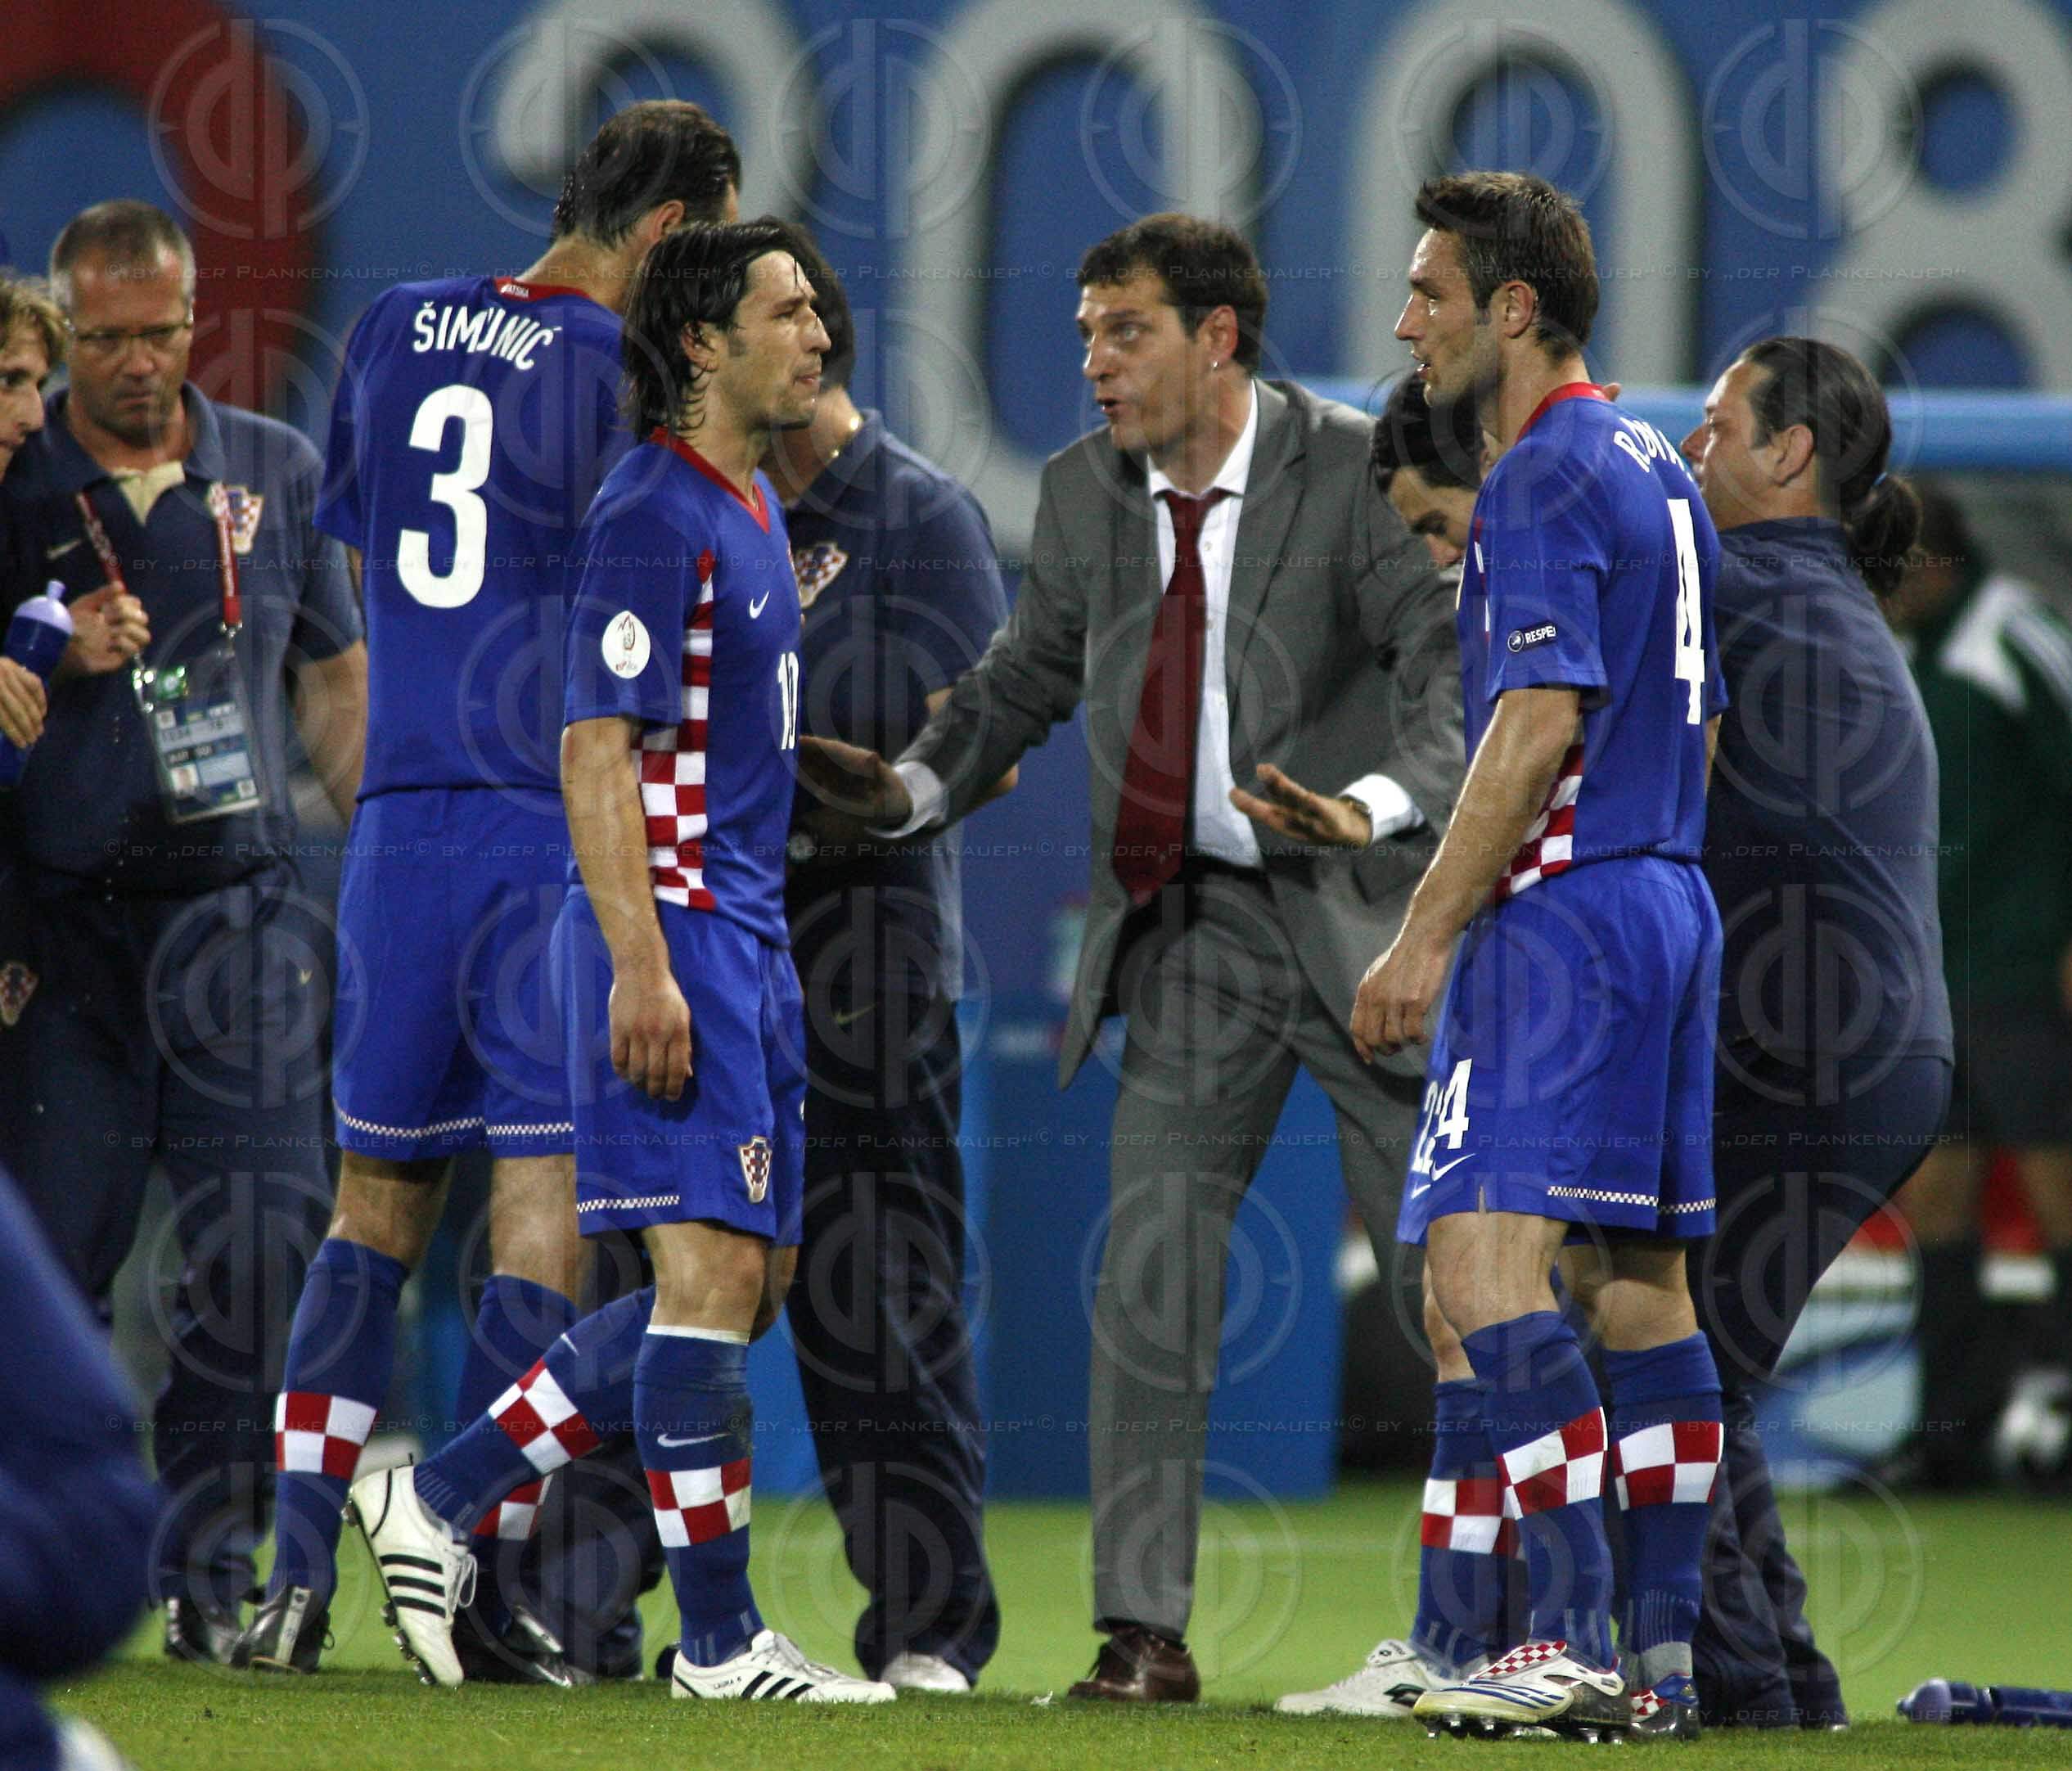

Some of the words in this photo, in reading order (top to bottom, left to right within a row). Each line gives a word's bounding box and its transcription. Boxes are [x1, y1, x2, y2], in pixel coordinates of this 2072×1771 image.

[397, 385, 494, 608] 3
[777, 651, 800, 750] 10
[1667, 498, 1705, 725] 4
